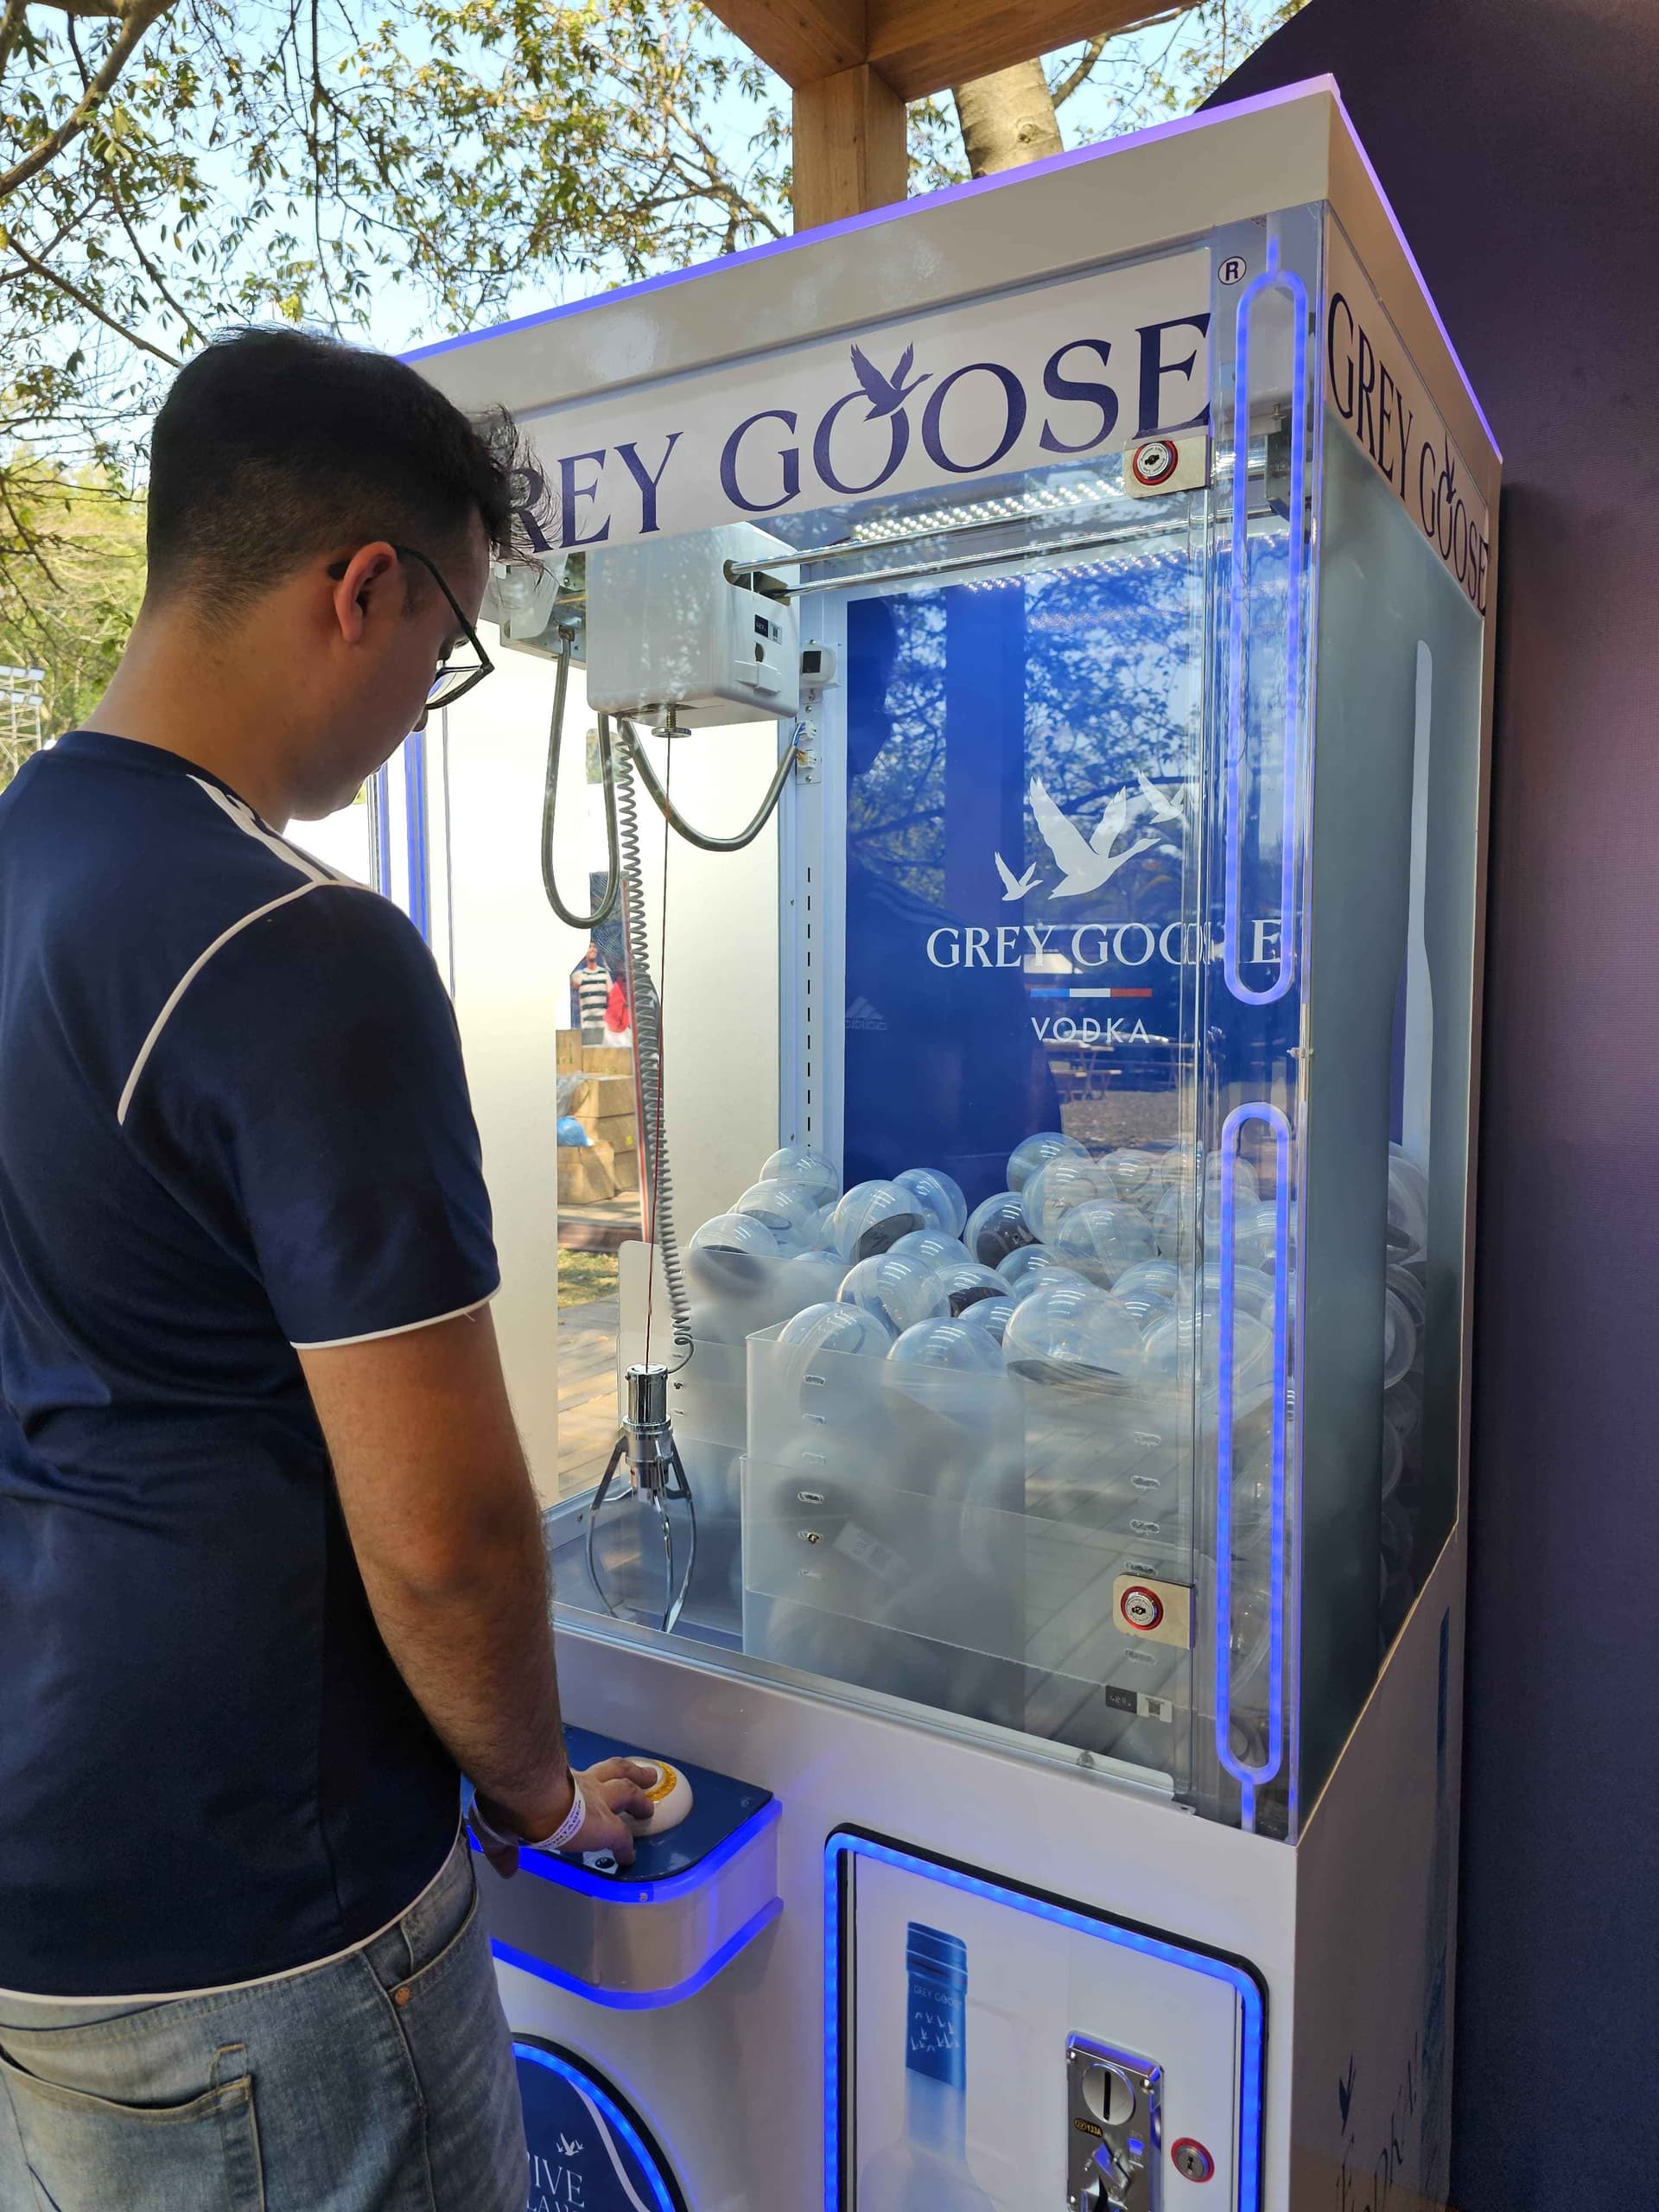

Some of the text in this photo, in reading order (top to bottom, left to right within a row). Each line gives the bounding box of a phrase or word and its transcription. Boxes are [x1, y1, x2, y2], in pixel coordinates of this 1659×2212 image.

[508, 431, 683, 554] REY
[719, 312, 1211, 512] GOOSE
[1327, 292, 1490, 616] GREY GOOSE
[926, 918, 1281, 968] GREY GOOE
[1031, 1016, 1151, 1045] VODKA
